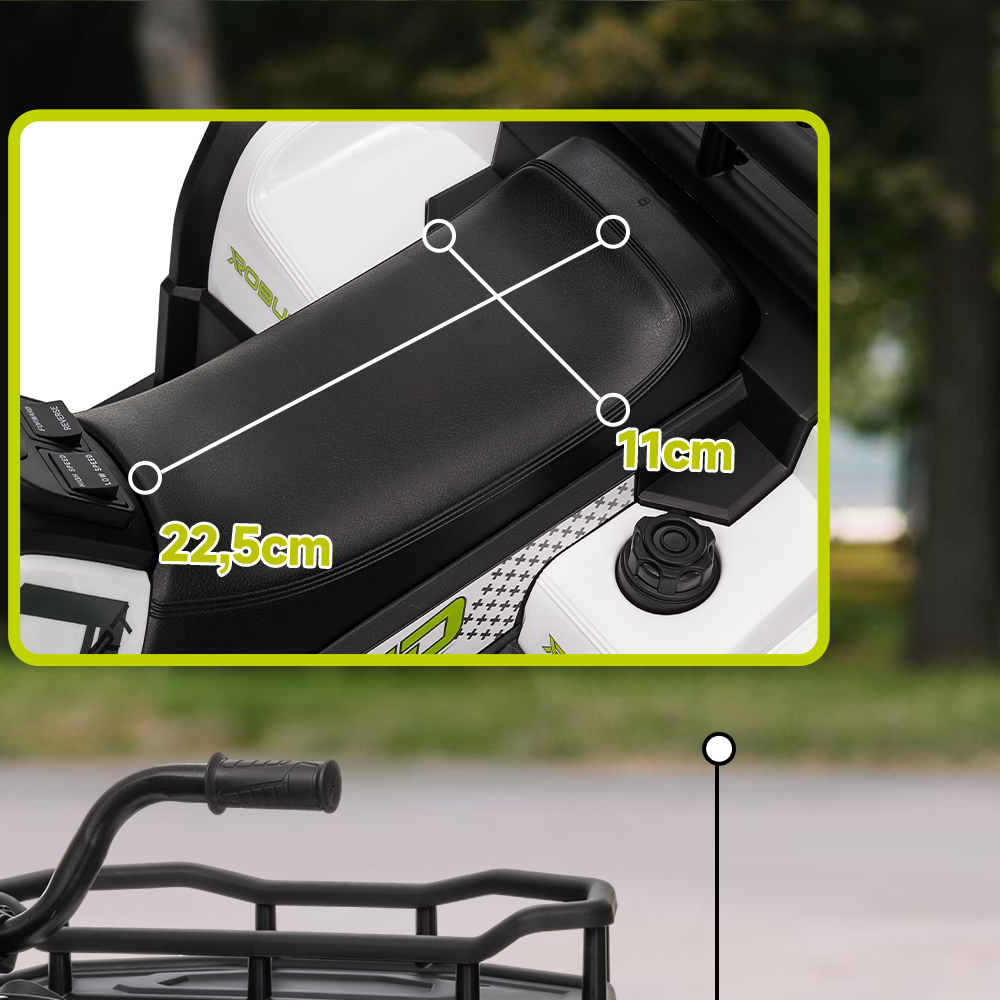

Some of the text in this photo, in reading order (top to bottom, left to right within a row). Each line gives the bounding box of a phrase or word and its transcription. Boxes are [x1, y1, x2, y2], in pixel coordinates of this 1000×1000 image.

[227, 246, 291, 322] ROBU
[24, 405, 46, 432] FORWARD
[49, 405, 72, 431] REVERSE
[59, 454, 87, 488] HIGH SPEED
[85, 453, 112, 486] LOW SPEED
